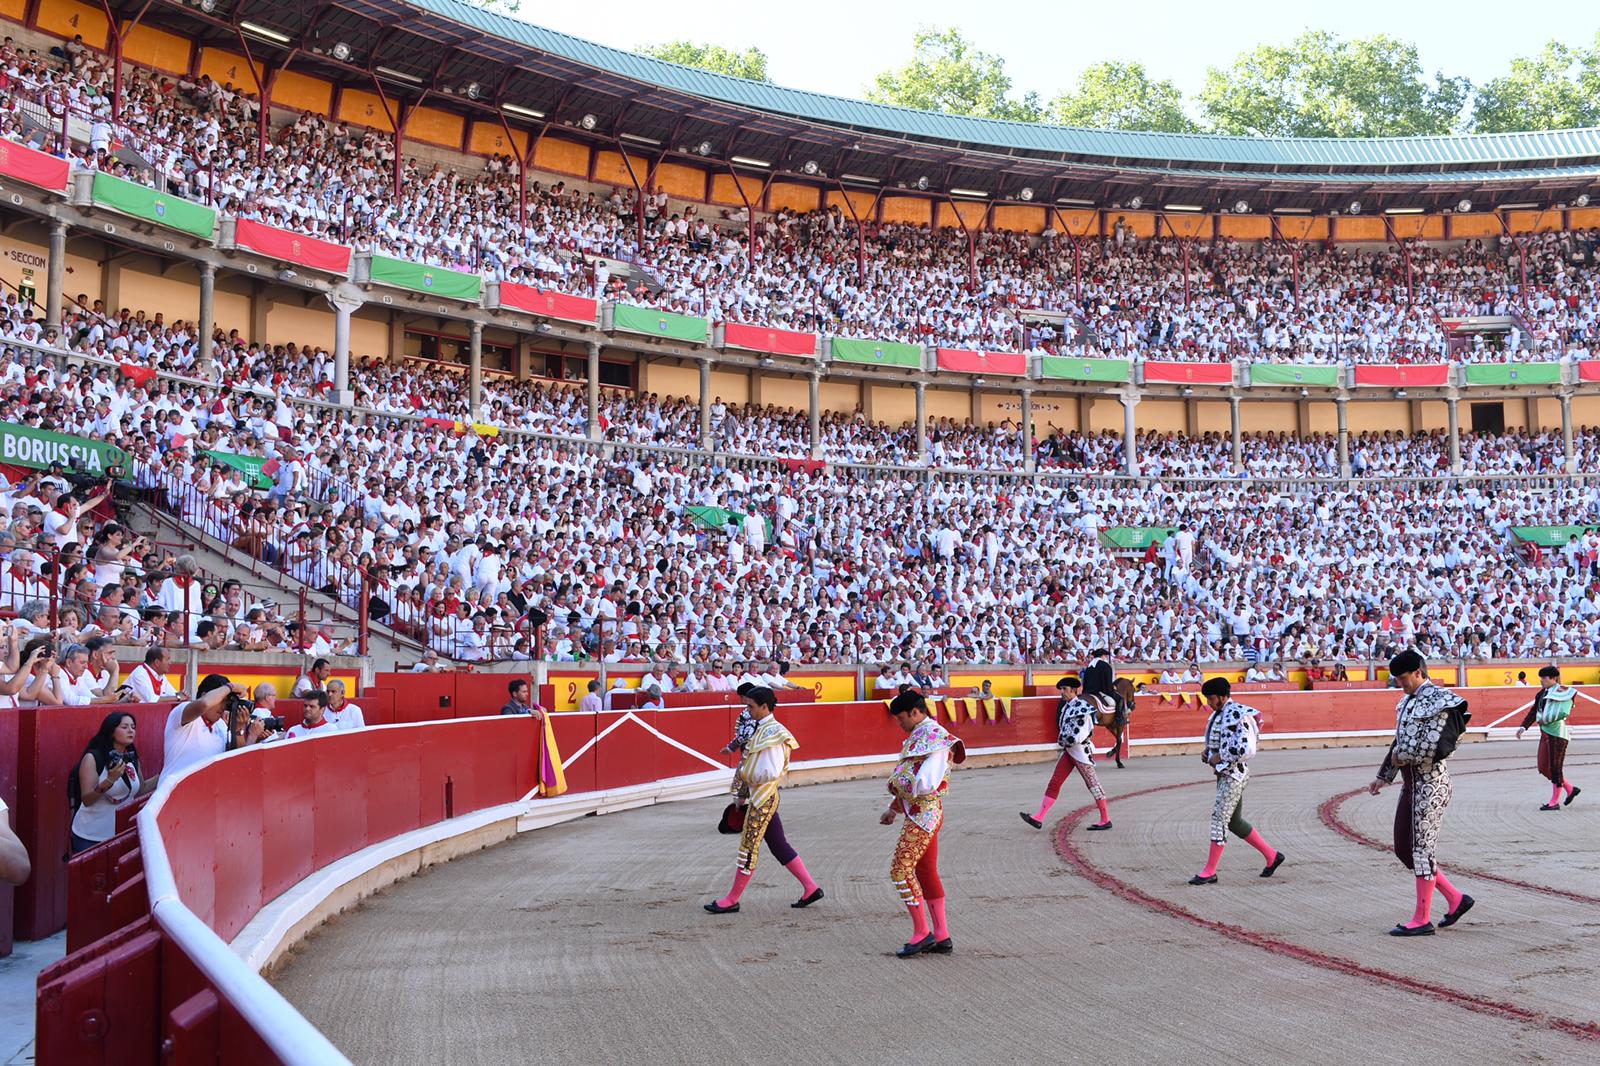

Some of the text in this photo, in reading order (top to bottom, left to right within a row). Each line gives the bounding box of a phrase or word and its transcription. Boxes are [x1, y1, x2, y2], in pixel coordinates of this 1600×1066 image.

[68, 13, 79, 29] 4
[226, 65, 237, 79] 4
[366, 103, 375, 117] 5
[495, 135, 503, 148] 5
[11, 250, 46, 268] SECCION
[1005, 402, 1010, 410] 2
[4, 433, 101, 472] BORUSSIA
[1503, 671, 1513, 685] 3
[567, 681, 577, 704] 2
[815, 681, 823, 699] 2
